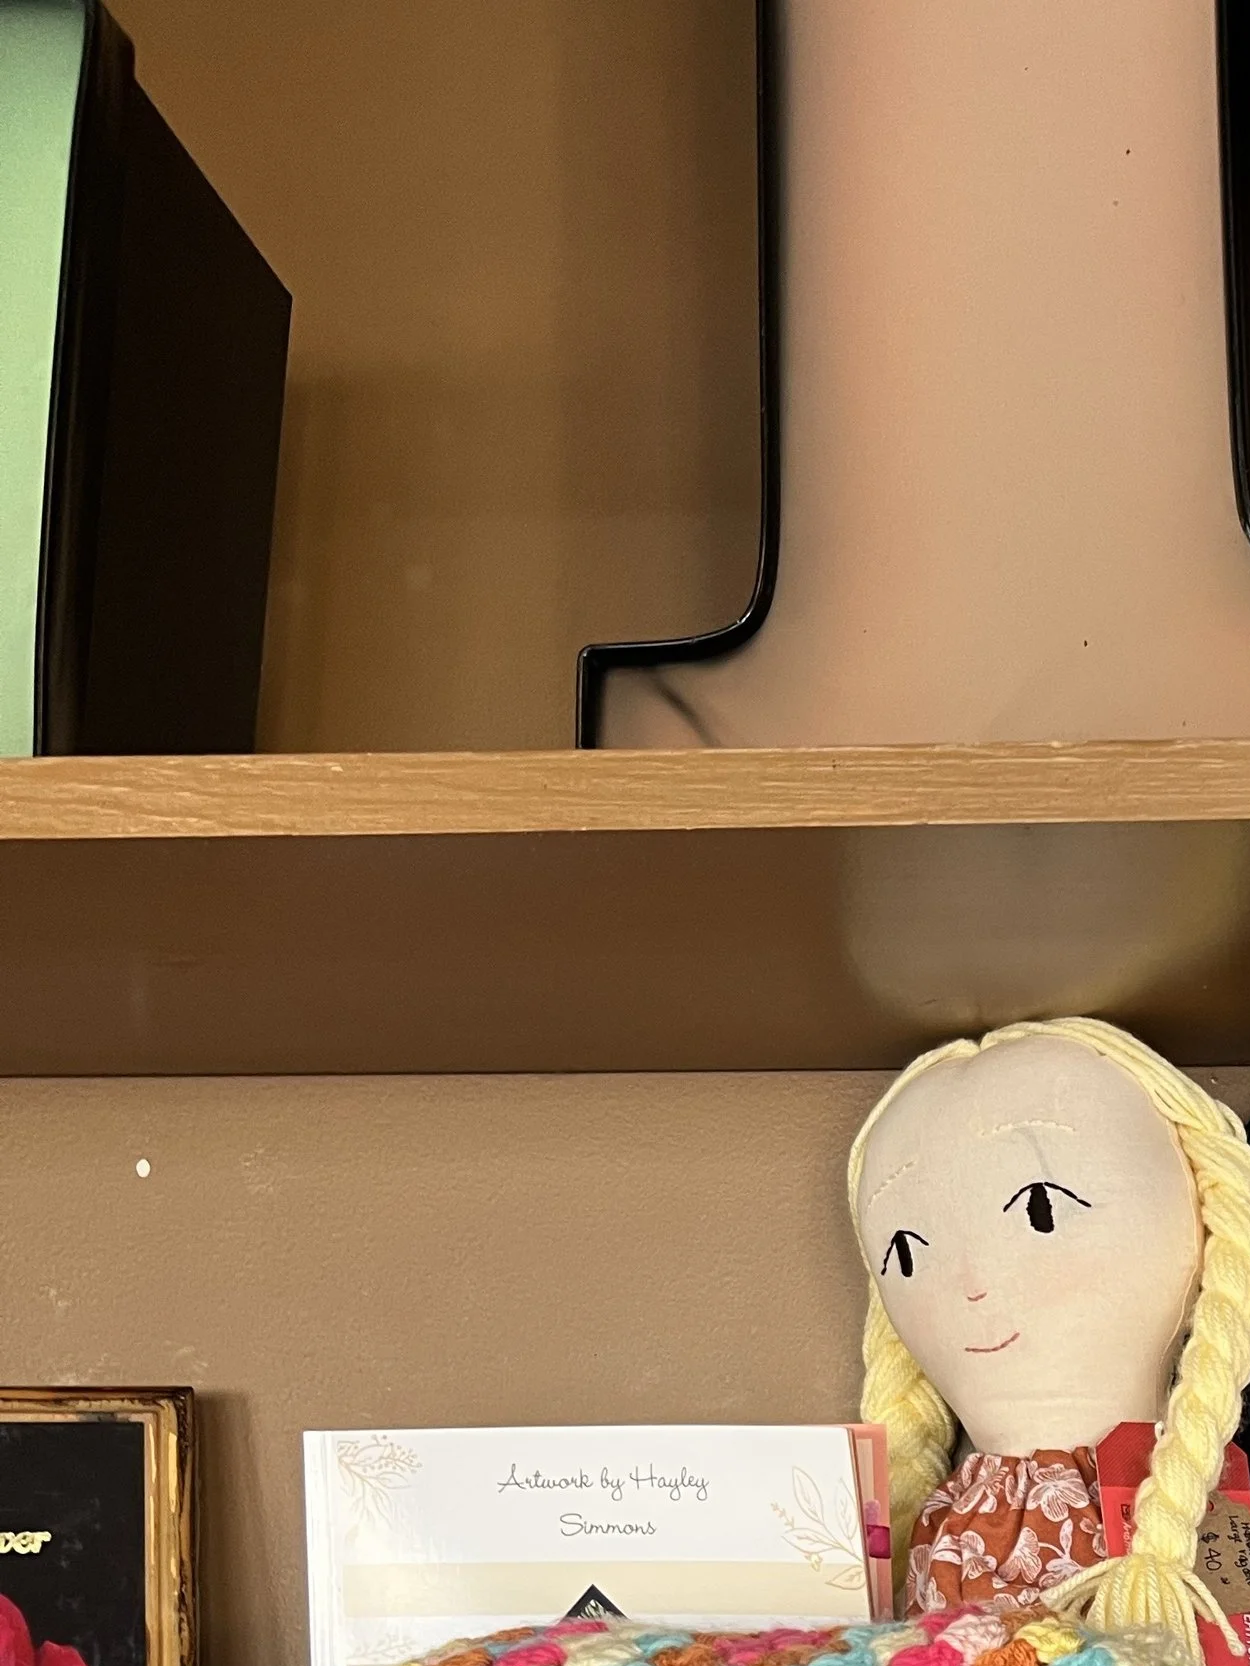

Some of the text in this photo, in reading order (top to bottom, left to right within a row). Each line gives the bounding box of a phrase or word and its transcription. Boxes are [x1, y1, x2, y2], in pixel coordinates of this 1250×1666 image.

[497, 1463, 710, 1501] Artwork by Hayley
[558, 1512, 657, 1538] Simmons
[1228, 1514, 1241, 1543] Large
